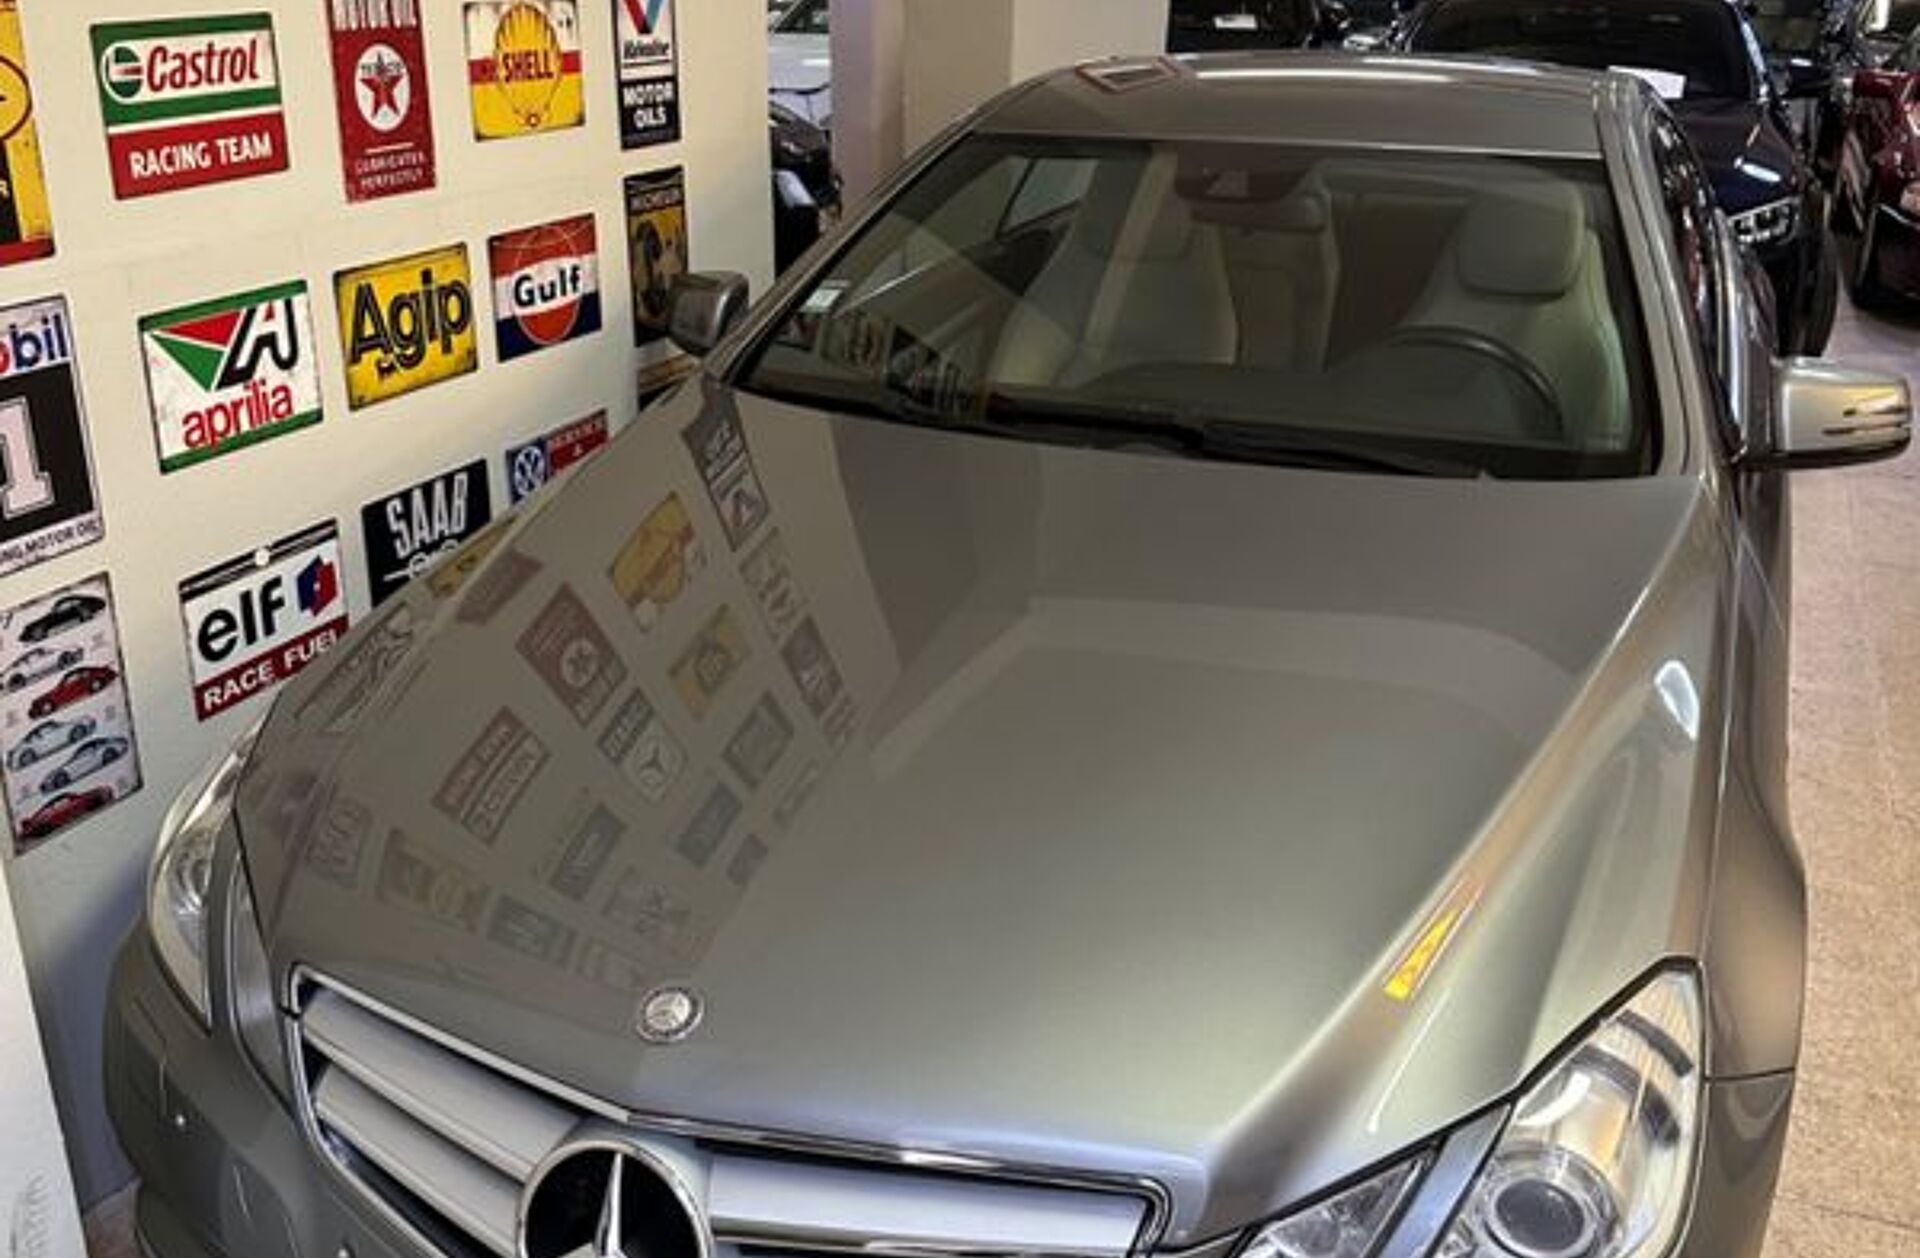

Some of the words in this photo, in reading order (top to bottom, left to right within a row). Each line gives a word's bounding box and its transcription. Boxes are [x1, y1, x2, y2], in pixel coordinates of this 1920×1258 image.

[146, 38, 260, 93] Castrol
[502, 49, 555, 83] SHELL
[623, 82, 674, 107] MOTOR
[633, 105, 667, 131] OILS
[129, 141, 212, 180] RACING
[216, 132, 273, 166] TEAM
[513, 264, 582, 309] Gulf
[350, 267, 473, 370] Agip
[181, 377, 295, 451] aprilia
[25, 526, 75, 552] MOTOR
[386, 470, 468, 559] SAAB
[197, 575, 286, 663] elf
[204, 660, 276, 711] RACE
